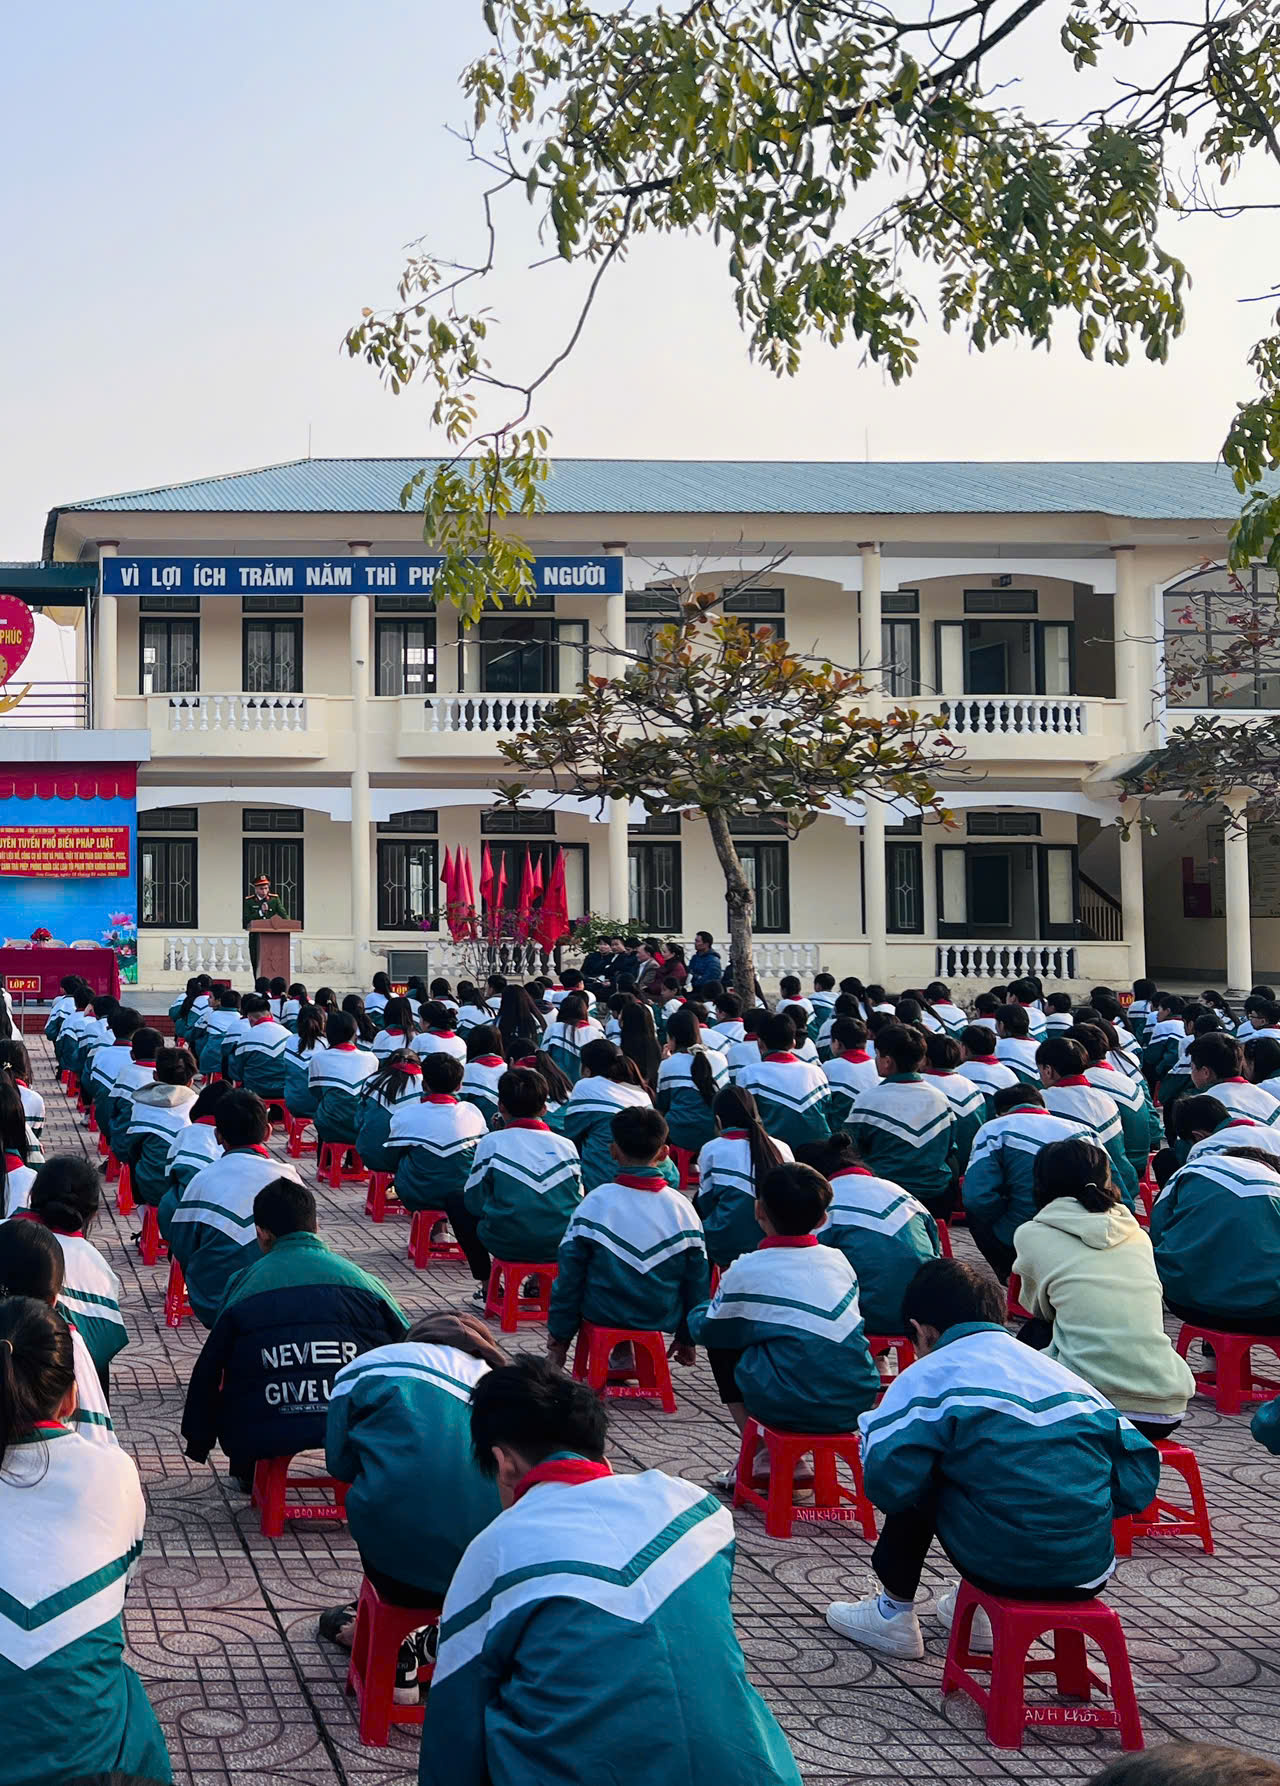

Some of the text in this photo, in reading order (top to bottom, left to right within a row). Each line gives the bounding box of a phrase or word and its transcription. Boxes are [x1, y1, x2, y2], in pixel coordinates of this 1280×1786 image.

[121, 564, 139, 587] VÌ
[152, 566, 181, 590] LỢI
[194, 563, 226, 587] ÍCH
[239, 563, 293, 586] TRĂM
[306, 562, 352, 586] NĂM
[365, 562, 396, 586] THÌ
[544, 562, 606, 586] NGƯỜI
[0, 626, 22, 645] PHÚC
[75, 835, 95, 849] PHÁP
[96, 835, 114, 851] LUẬT
[10, 979, 37, 989] LỚP 7C
[261, 1341, 357, 1368] NEVER
[265, 1380, 319, 1405] GIVE
[1024, 1709, 1058, 1721] ANH
